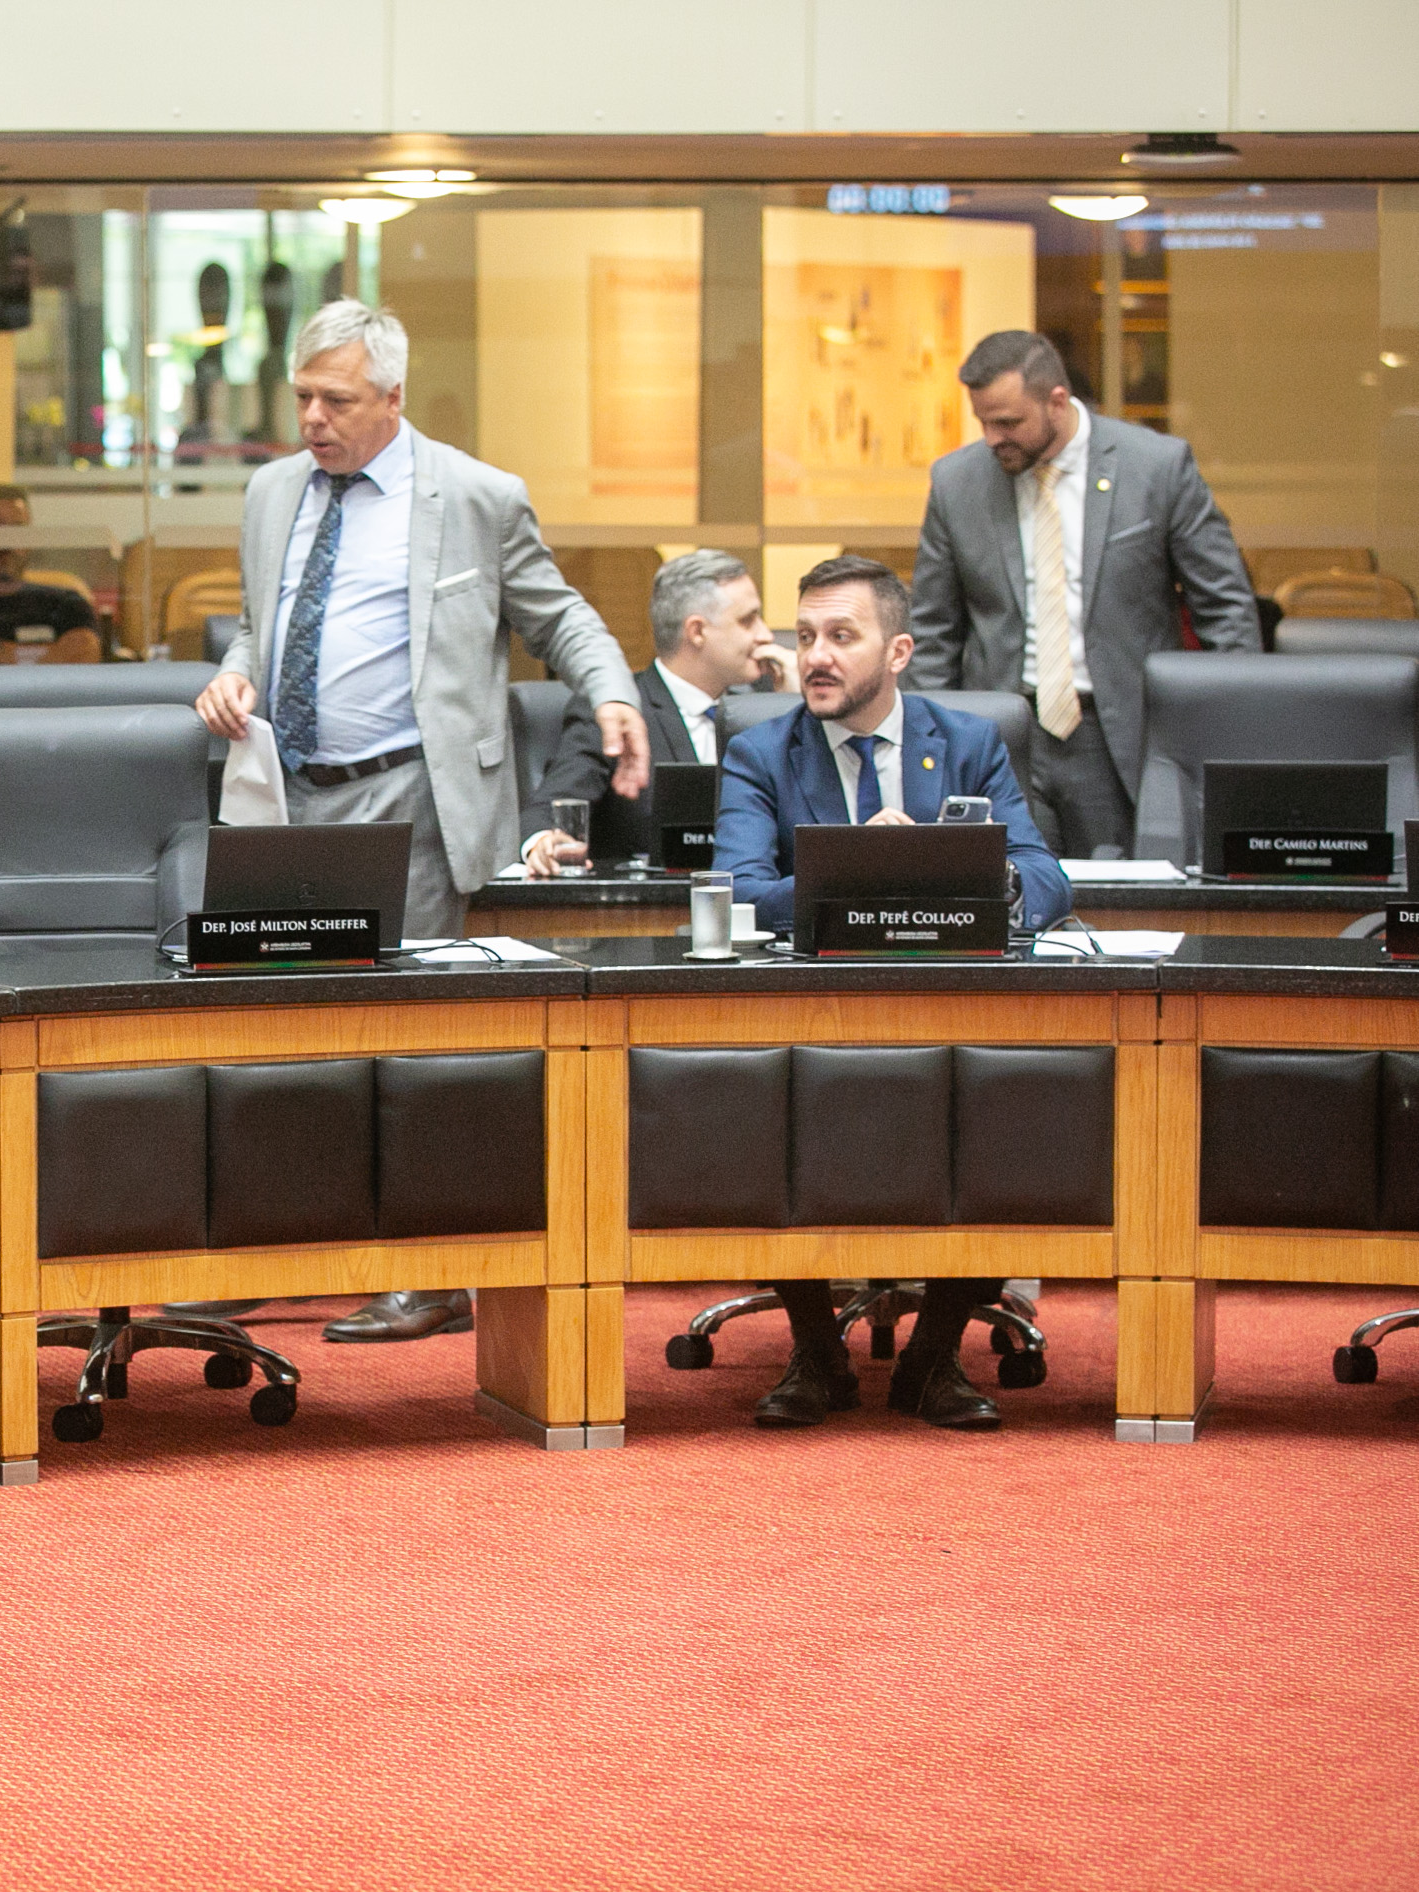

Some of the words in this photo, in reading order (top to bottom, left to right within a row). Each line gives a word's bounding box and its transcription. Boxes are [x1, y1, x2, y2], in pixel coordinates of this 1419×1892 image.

[1274, 837, 1318, 850] CAMILO
[1319, 839, 1368, 851] MARTINS
[202, 921, 227, 934] DEP.
[230, 919, 257, 935] JOSÉ
[260, 920, 307, 932] MILTON
[310, 918, 368, 931] SCHEFFER
[848, 911, 876, 924] DEP.
[879, 910, 909, 924] PEPÊ
[912, 911, 975, 927] COLLAÇO
